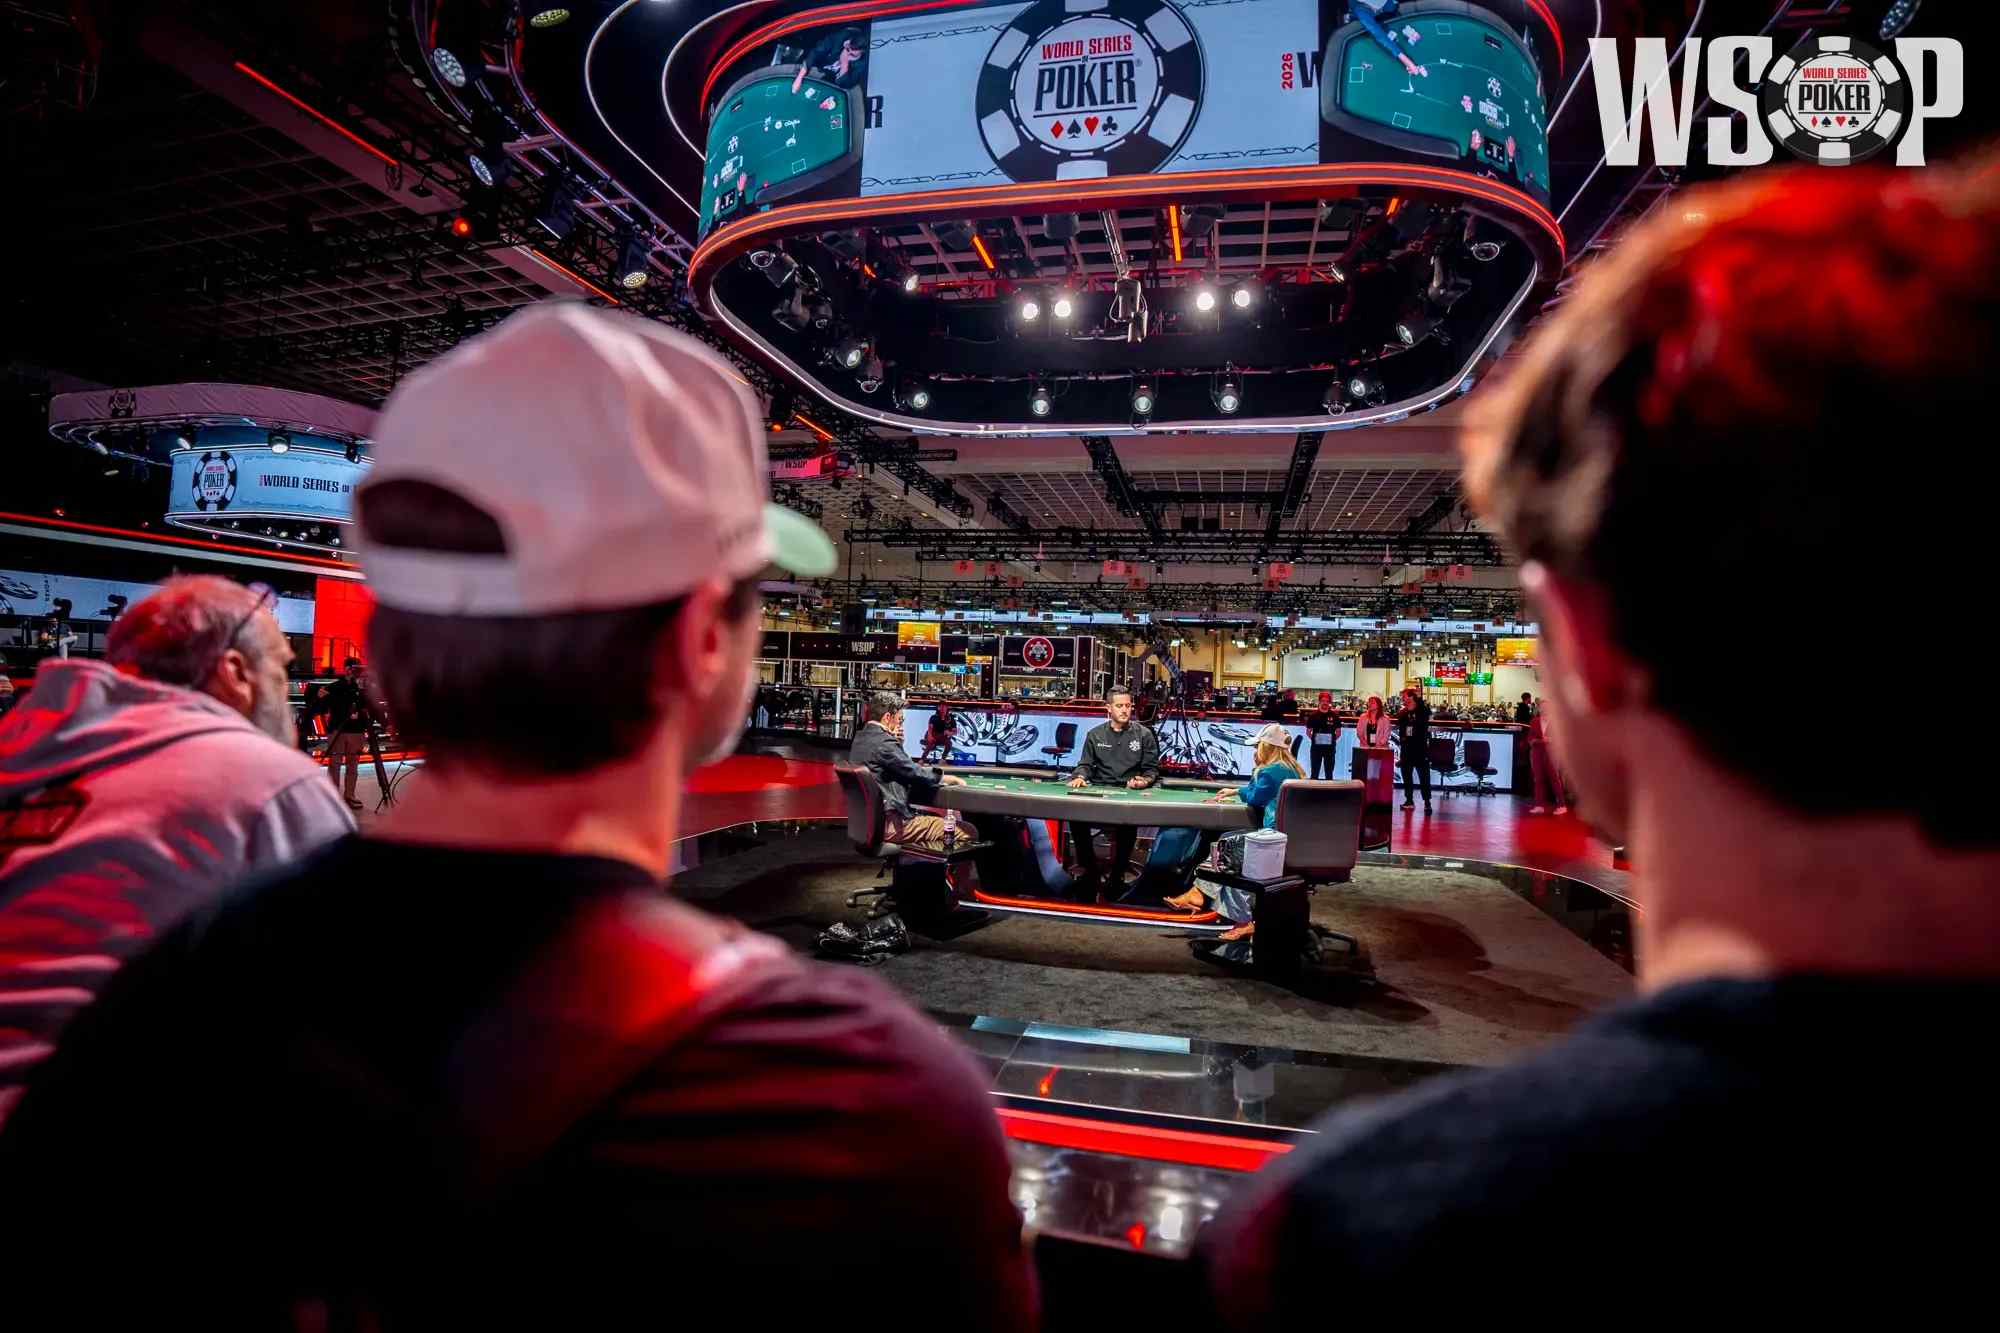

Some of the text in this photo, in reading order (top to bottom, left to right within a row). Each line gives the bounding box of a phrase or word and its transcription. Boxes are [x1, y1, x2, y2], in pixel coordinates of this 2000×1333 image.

[1042, 34, 1132, 60] WORLD SERIES
[1281, 52, 1294, 89] 2026
[1034, 60, 1137, 111] POKER
[263, 474, 299, 488] WORLD
[302, 477, 339, 493] SERIES
[851, 641, 875, 652] WSOP
